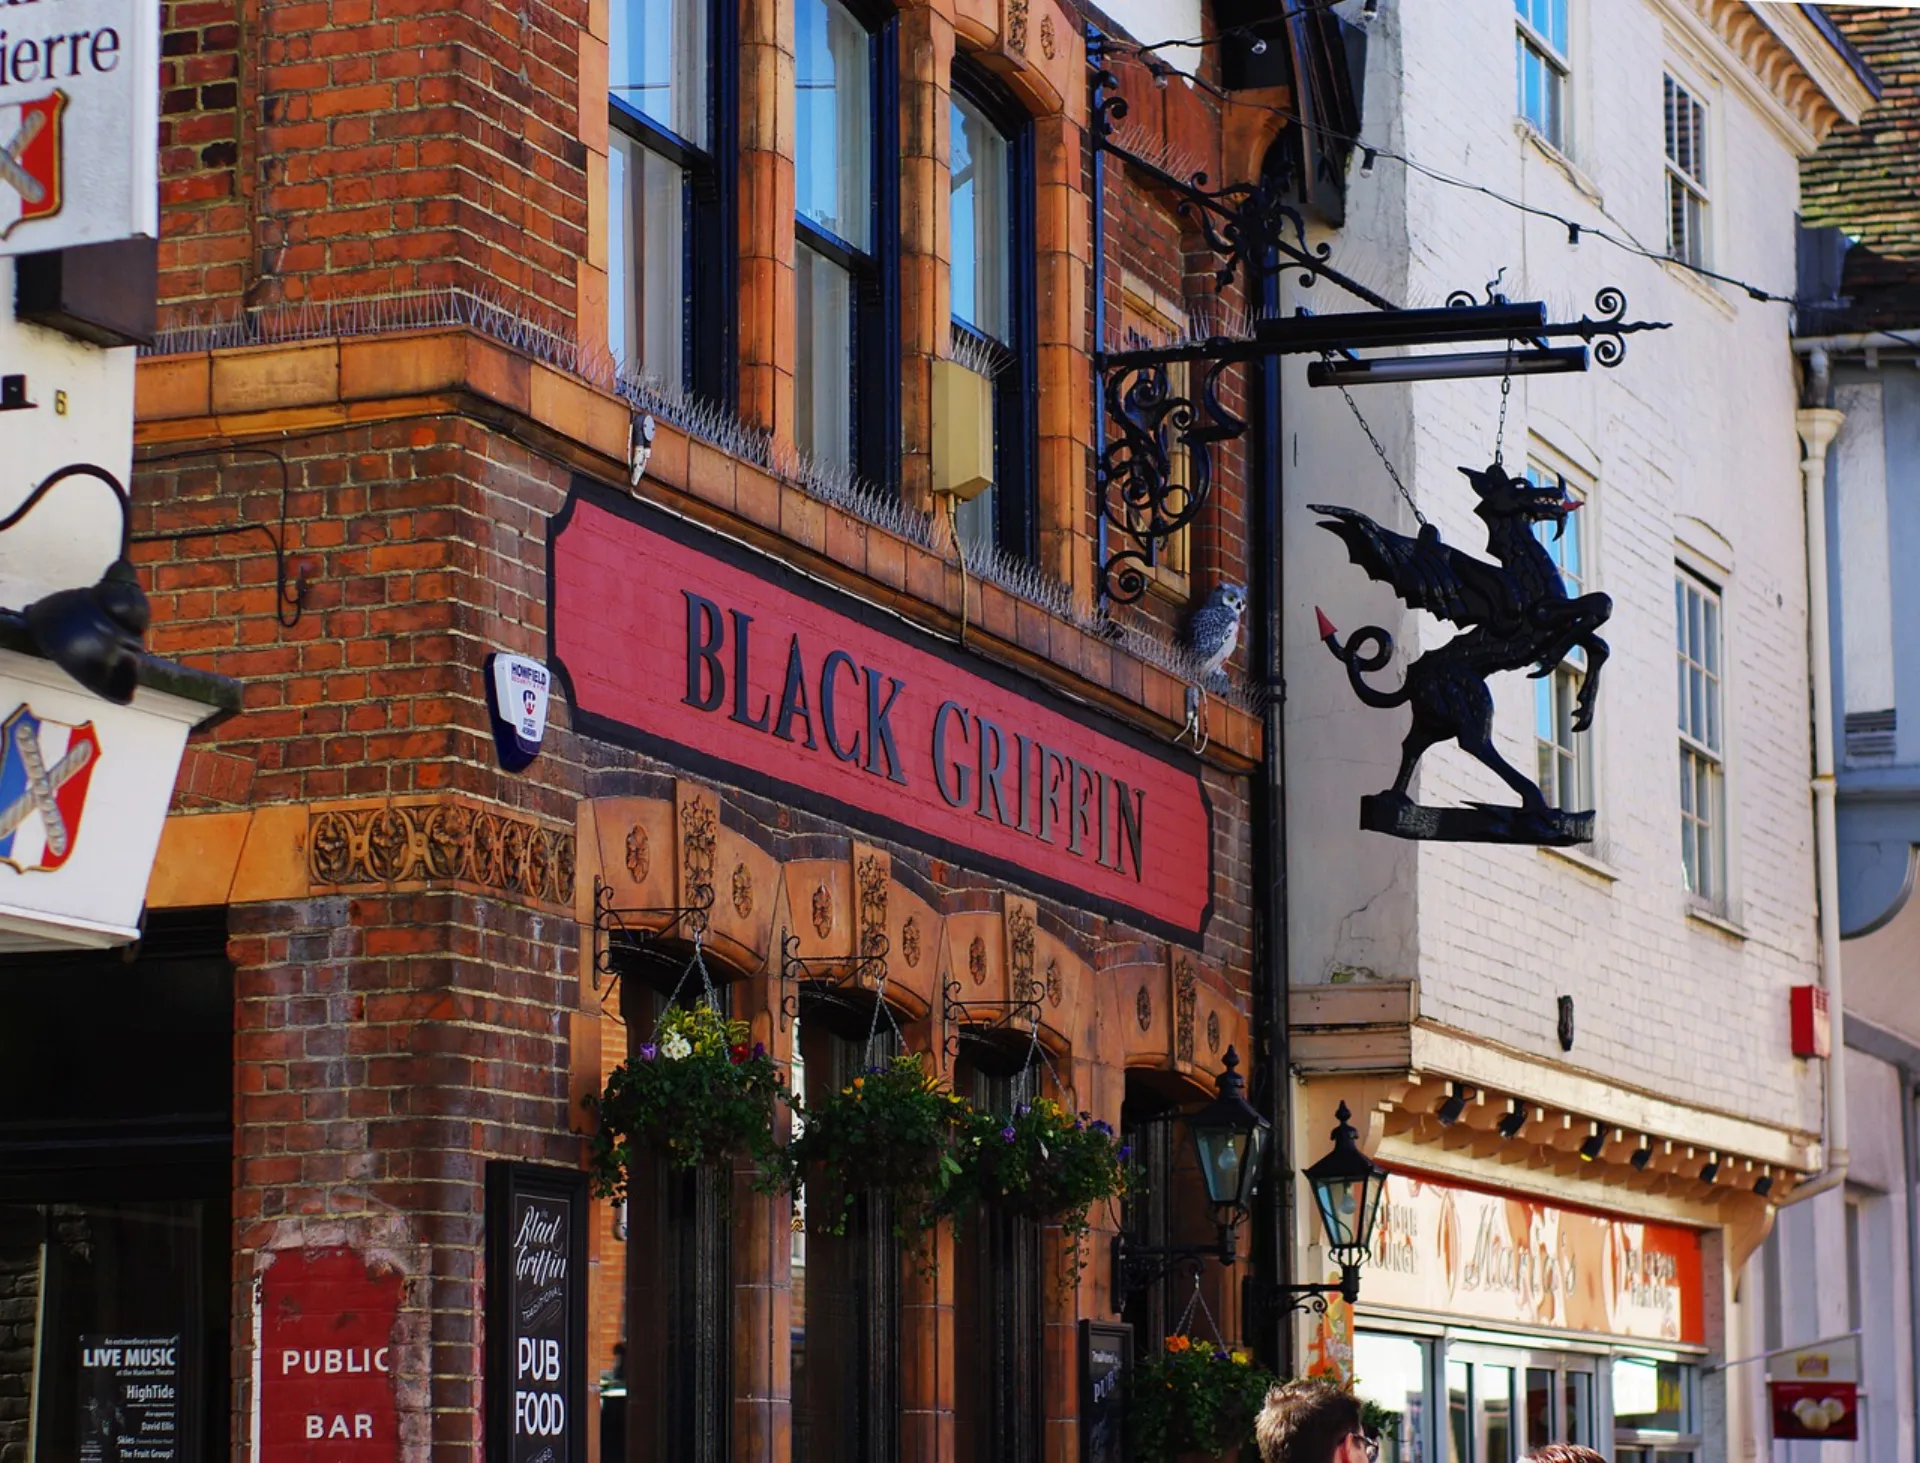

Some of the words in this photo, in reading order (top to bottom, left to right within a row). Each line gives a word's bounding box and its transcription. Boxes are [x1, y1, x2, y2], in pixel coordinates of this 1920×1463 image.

[55, 389, 67, 416] 6
[681, 589, 907, 785] BLACK
[932, 700, 1146, 883] GRIFFIN
[514, 1205, 563, 1251] Black
[516, 1245, 567, 1287] Griffin
[83, 1348, 122, 1367] LIVE
[124, 1347, 176, 1367] MUSIC
[282, 1347, 389, 1375] PUBLIC
[518, 1336, 560, 1382] PUB
[126, 1384, 175, 1402] HighTide
[141, 1421, 161, 1431] David
[306, 1414, 373, 1439] BAR
[515, 1390, 565, 1437] FOOD
[120, 1449, 133, 1458] The
[134, 1449, 150, 1458] Fruit
